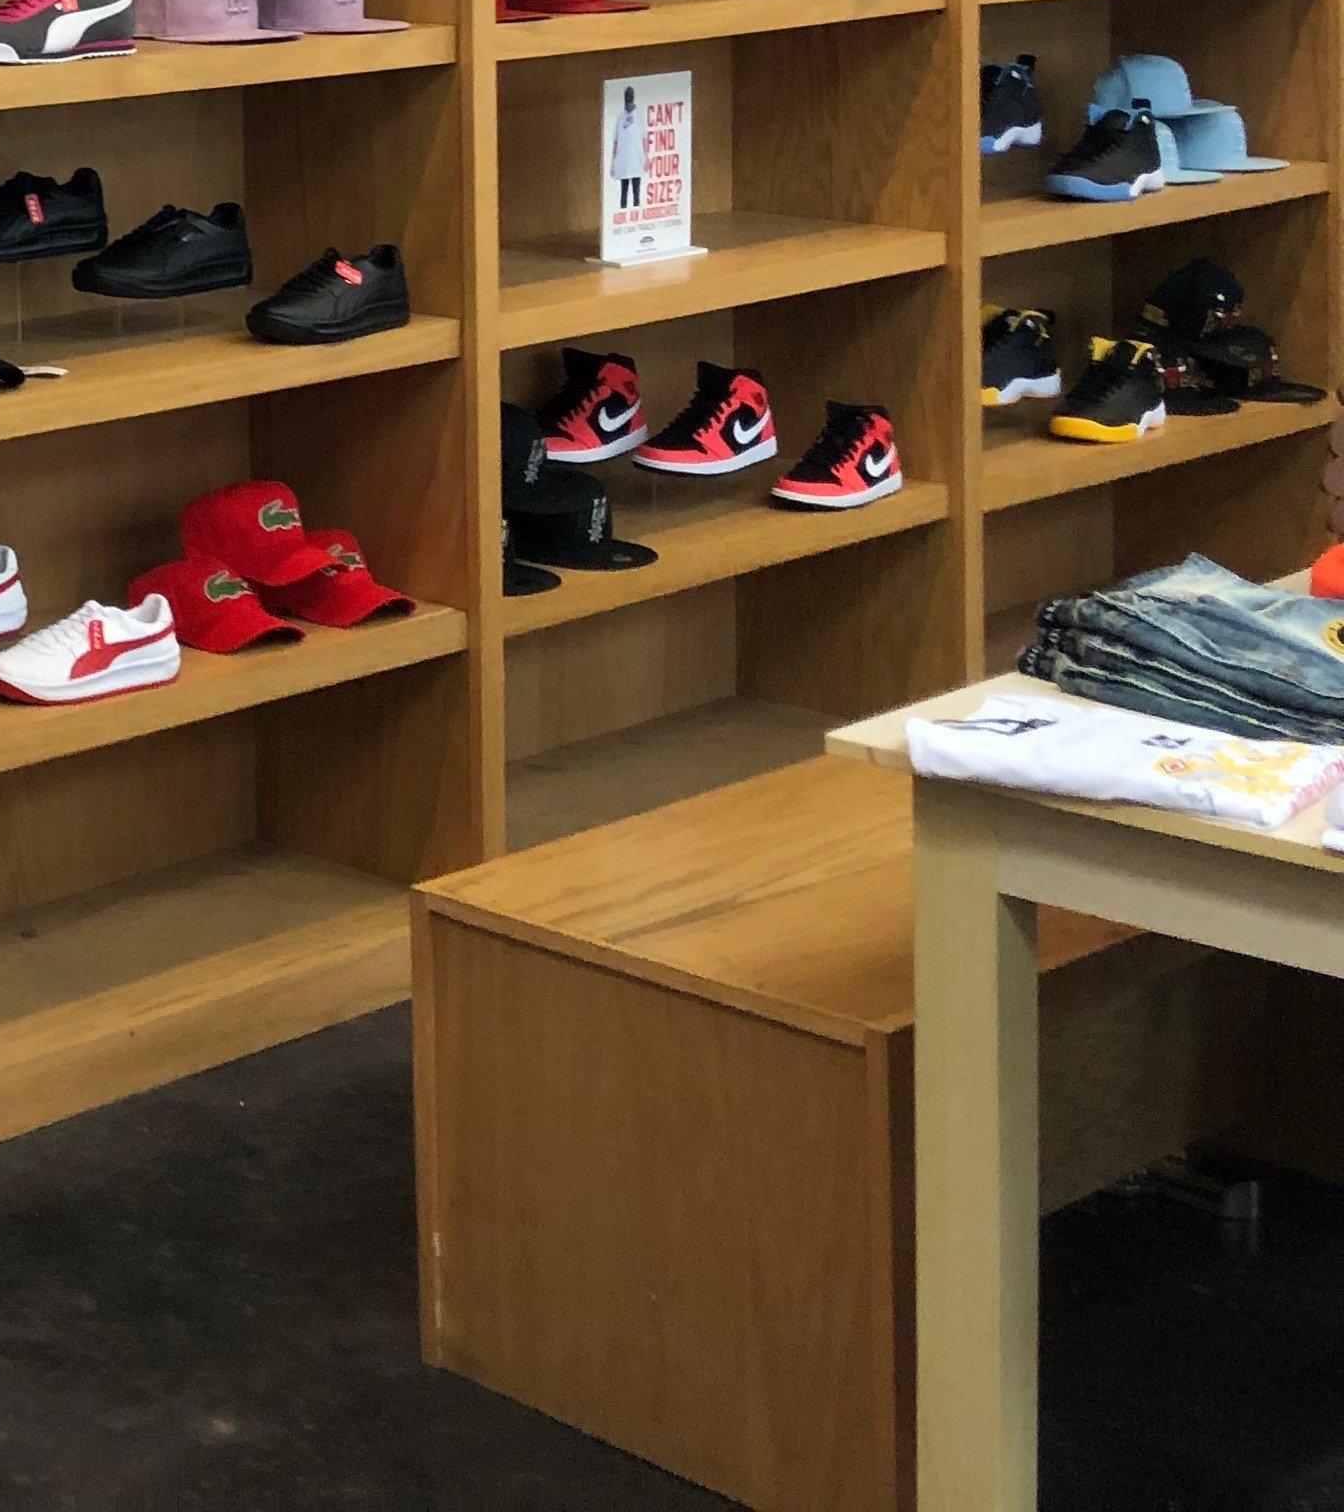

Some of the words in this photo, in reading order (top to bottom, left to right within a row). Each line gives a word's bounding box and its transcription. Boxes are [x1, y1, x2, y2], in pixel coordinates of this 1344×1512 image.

[647, 101, 684, 127] CAN'T
[647, 129, 675, 151] FIND
[646, 154, 680, 178] YOUR
[646, 179, 682, 204] SIZE?
